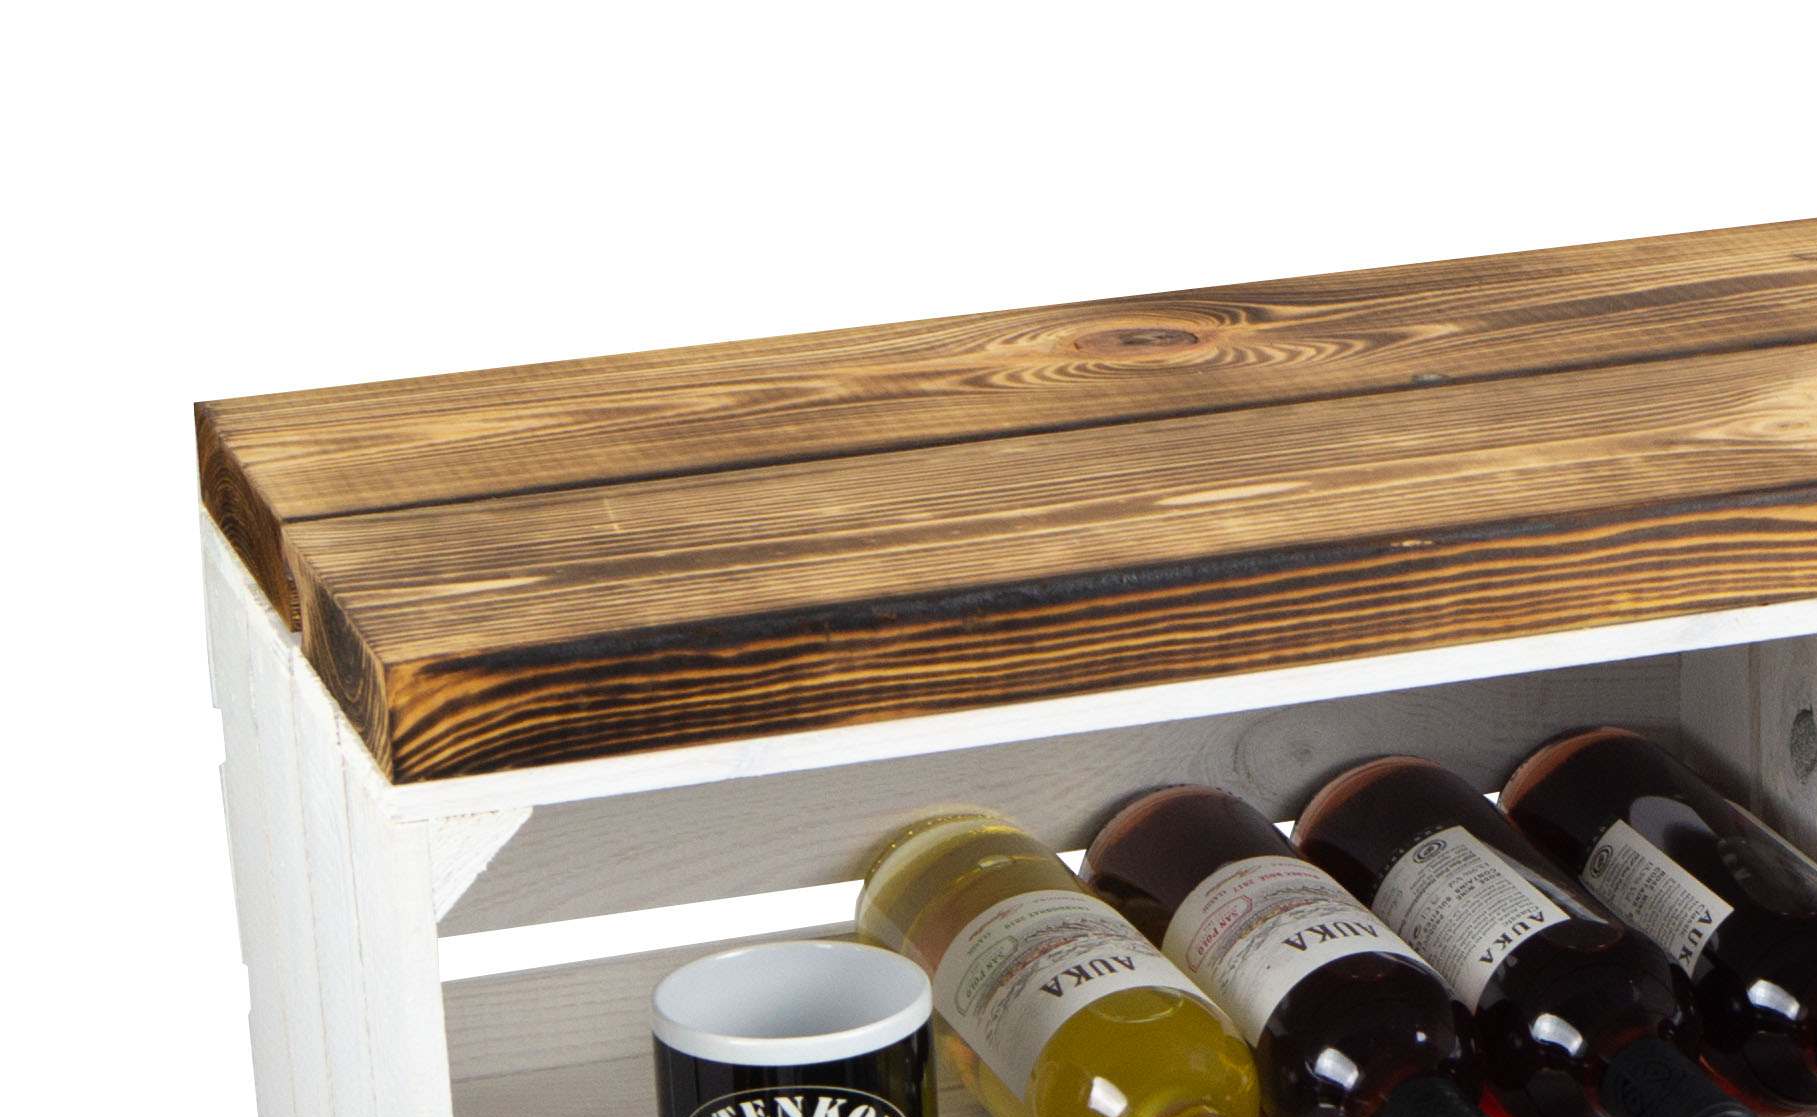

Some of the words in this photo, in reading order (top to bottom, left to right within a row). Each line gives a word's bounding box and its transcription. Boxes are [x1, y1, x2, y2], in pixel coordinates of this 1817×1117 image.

[1454, 867, 1497, 893] CONTAINS
[1282, 920, 1379, 952] AUKA
[1480, 910, 1545, 964] AUKA
[1679, 908, 1713, 968] AUK
[1040, 955, 1136, 998] AUKA
